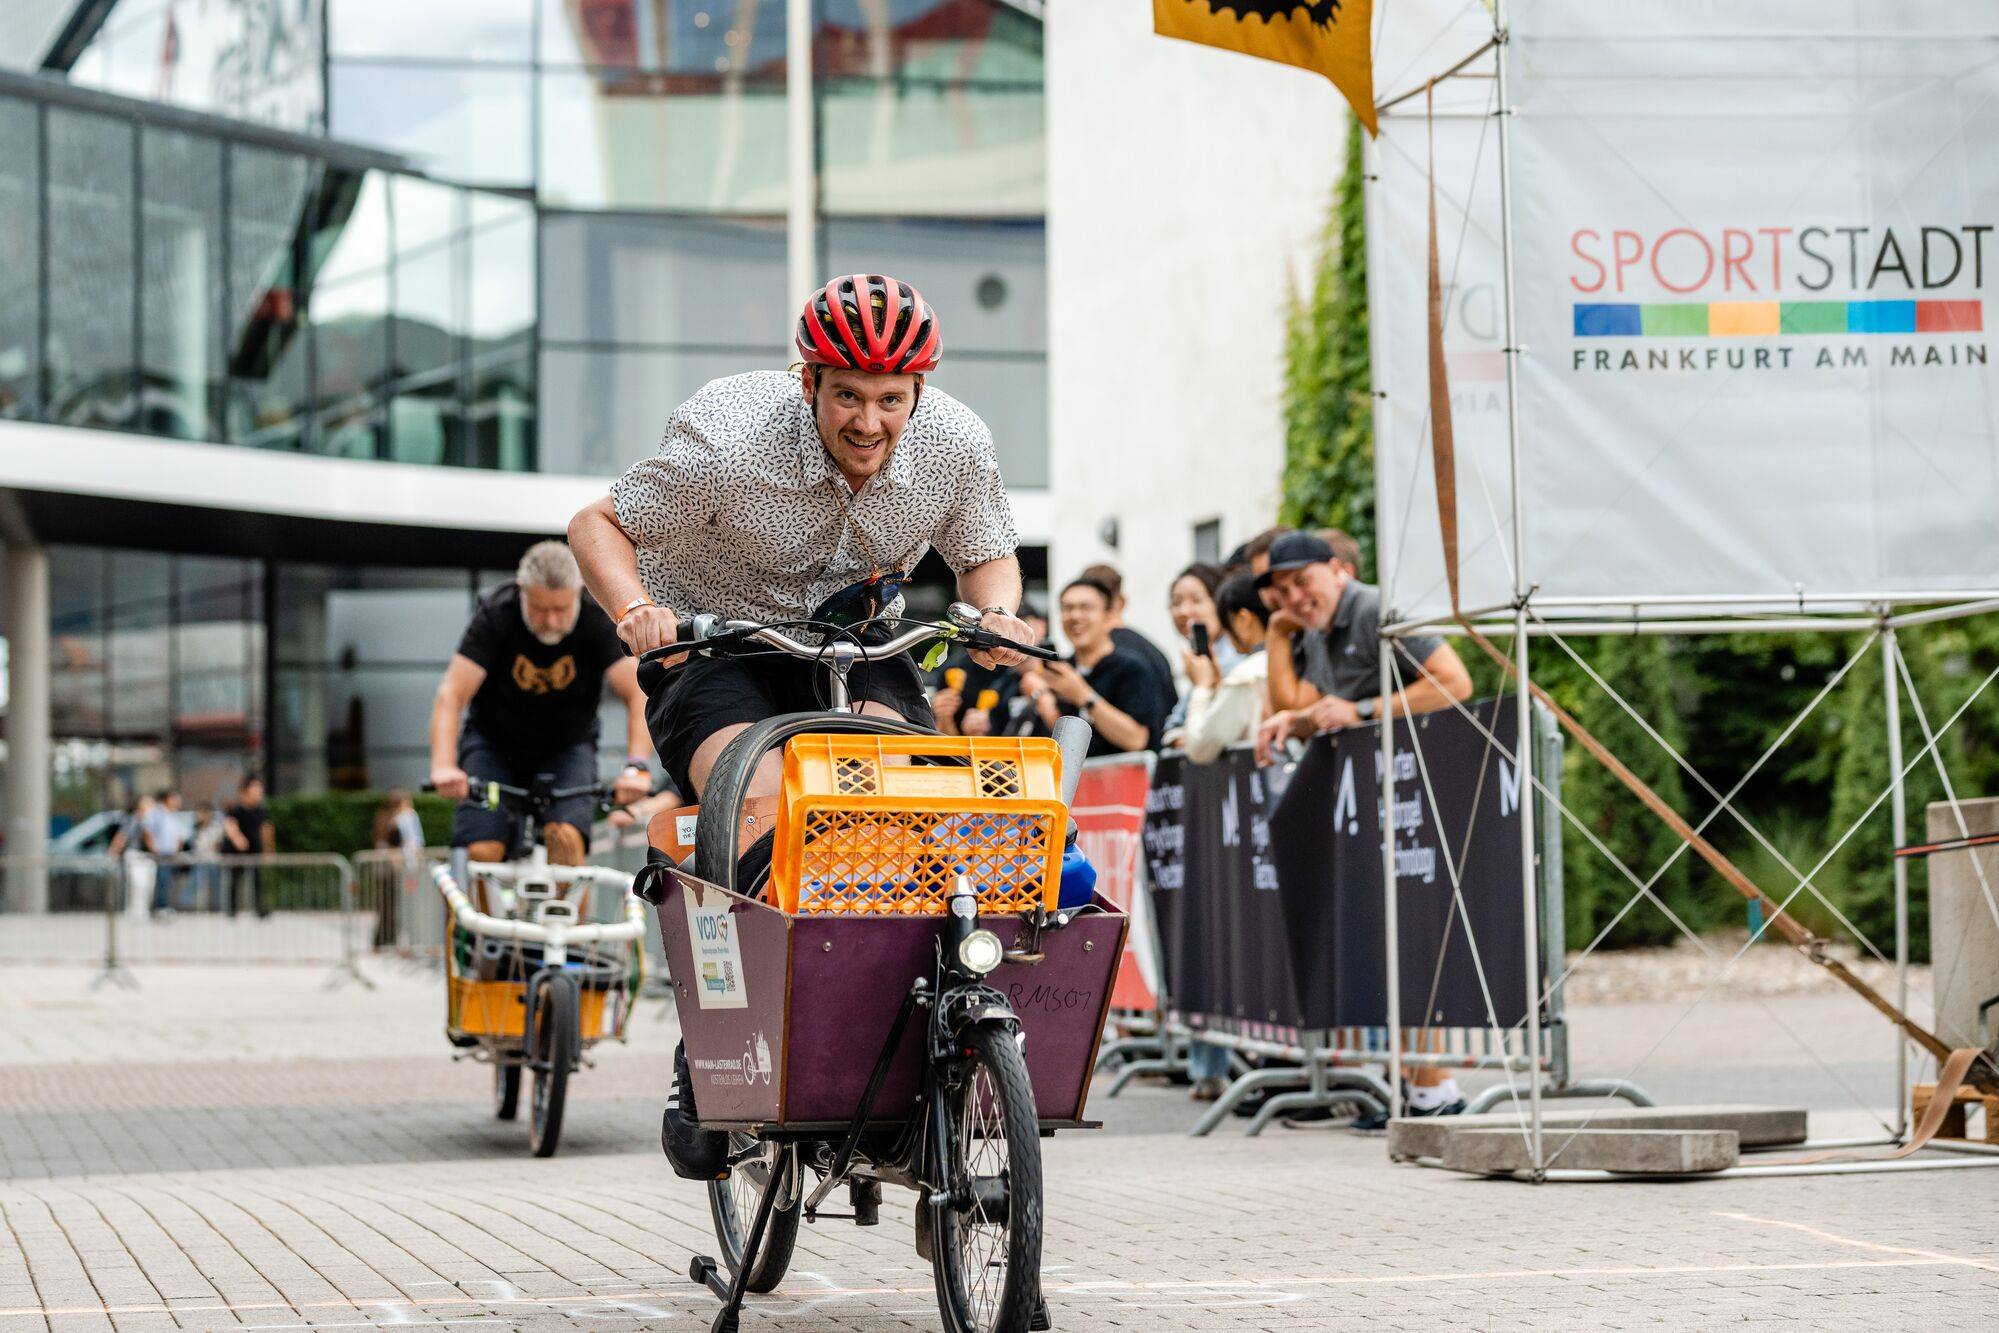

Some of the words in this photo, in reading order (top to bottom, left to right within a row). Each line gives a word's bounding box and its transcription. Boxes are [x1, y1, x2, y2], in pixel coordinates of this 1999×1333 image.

[1570, 225, 1994, 294] SPORTSTADT
[1573, 347, 1794, 371] FRANKFURT
[1815, 345, 1868, 368] AM
[1891, 344, 1988, 366] MAIN
[696, 915, 717, 940] VCD
